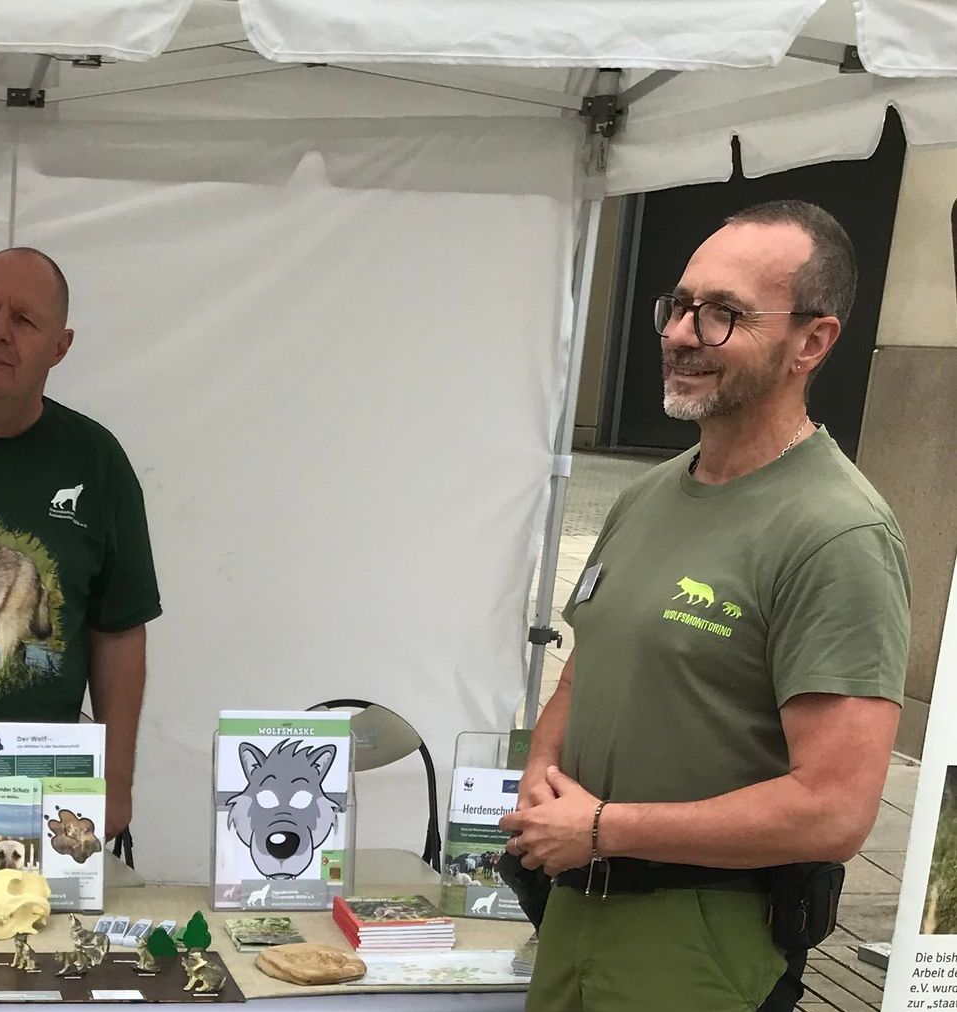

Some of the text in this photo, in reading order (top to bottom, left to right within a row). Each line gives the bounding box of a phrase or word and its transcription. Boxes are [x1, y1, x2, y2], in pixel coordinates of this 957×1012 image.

[258, 727, 315, 735] WOLFSMASKE
[915, 952, 933, 963] Die
[911, 967, 945, 978] Arbeit
[909, 983, 929, 993] e.V.
[906, 1000, 925, 1008] zur
